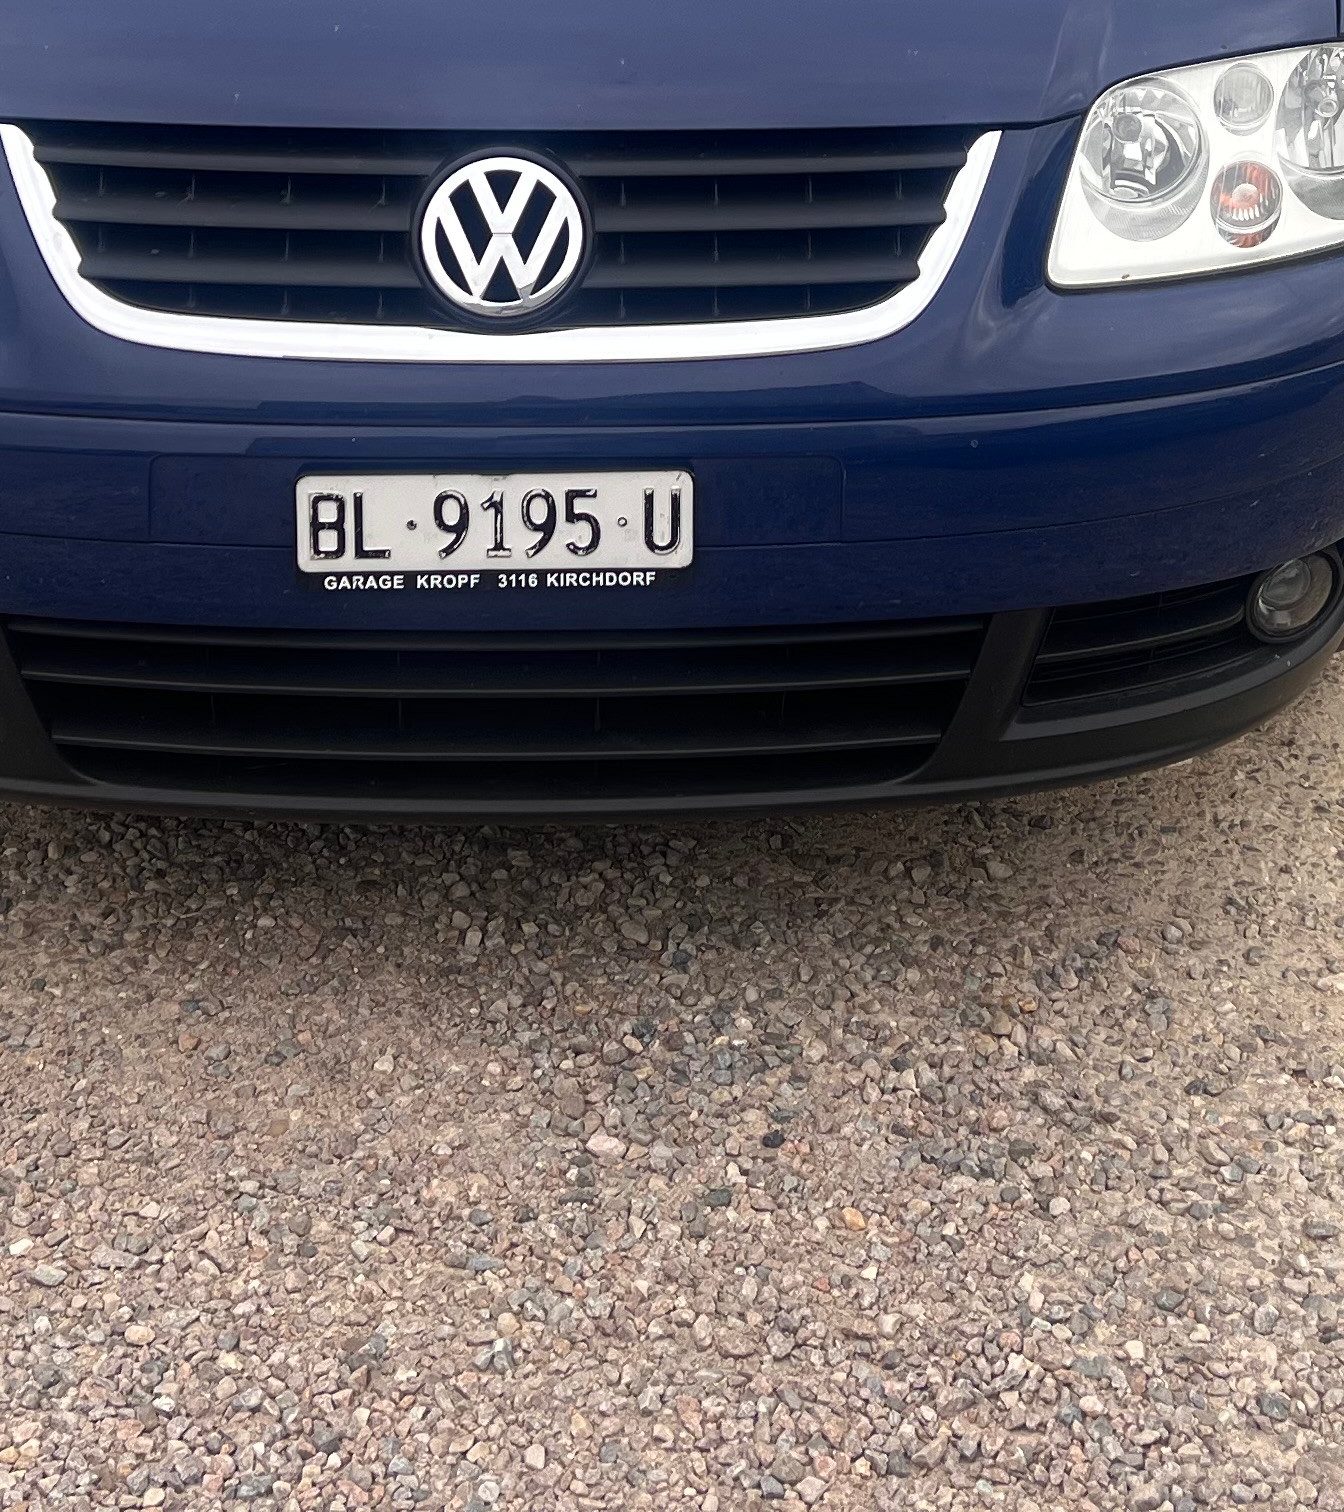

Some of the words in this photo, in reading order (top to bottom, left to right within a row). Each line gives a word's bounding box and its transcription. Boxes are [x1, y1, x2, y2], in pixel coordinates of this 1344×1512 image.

[421, 156, 583, 316] VW
[308, 491, 391, 559] BL
[433, 488, 601, 559] 9195
[643, 487, 681, 556] U
[324, 575, 404, 590] GARAGE
[416, 574, 480, 589] KROPF
[498, 573, 538, 588] 3116
[546, 571, 657, 587] KIRCHDORF
